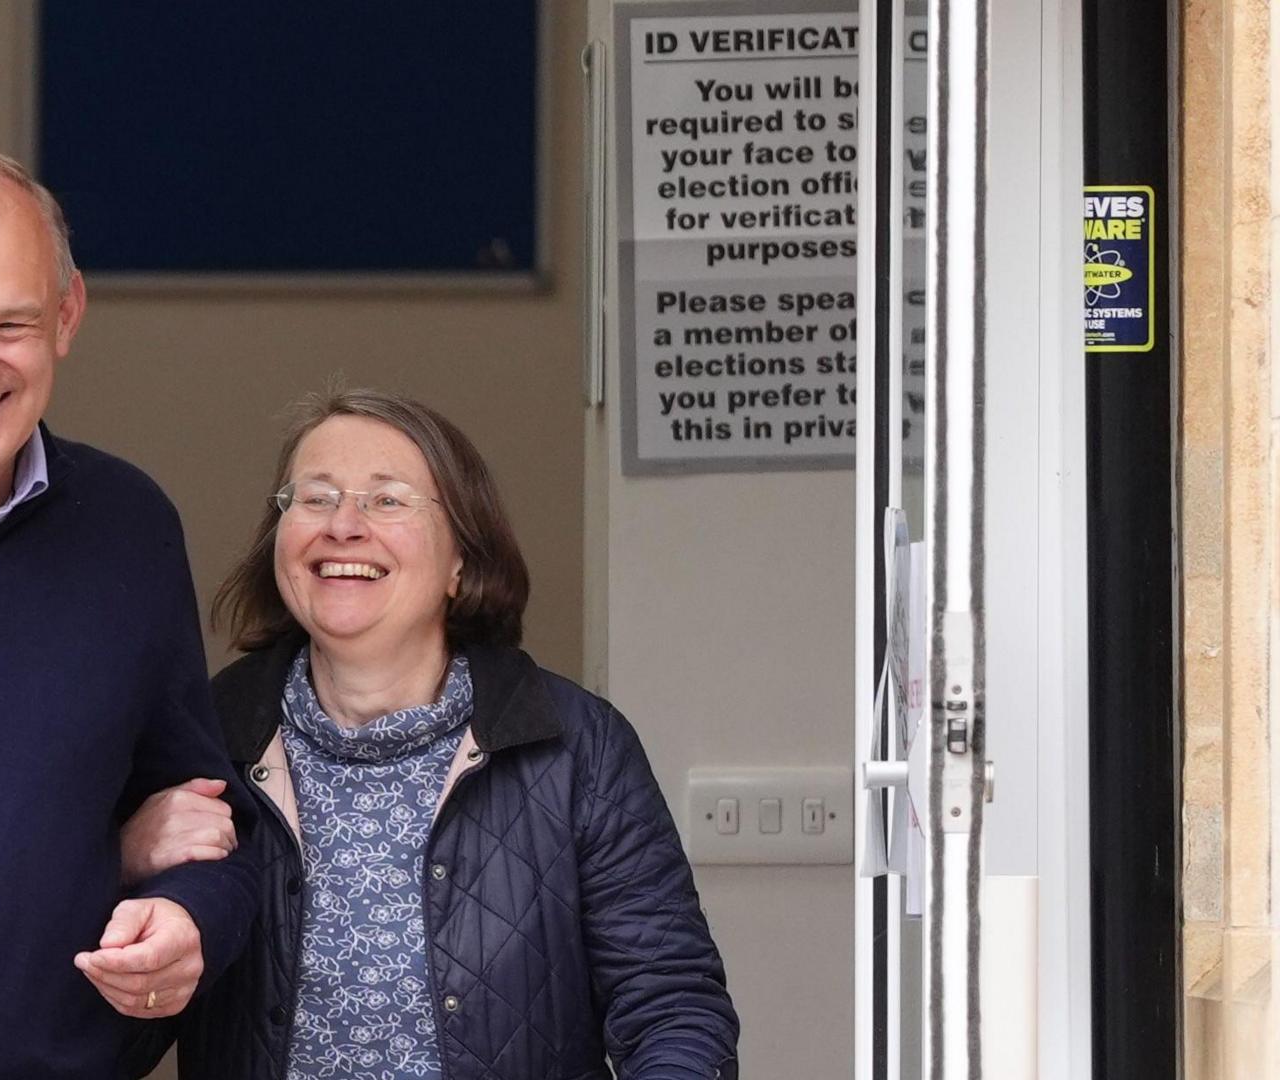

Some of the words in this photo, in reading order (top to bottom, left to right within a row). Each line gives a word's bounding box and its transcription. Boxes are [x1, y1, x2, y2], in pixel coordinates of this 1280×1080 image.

[645, 32, 677, 54] ID
[689, 26, 859, 53] VERIFICAT
[695, 79, 752, 102] You
[765, 76, 821, 100] will
[646, 110, 783, 140] required
[794, 109, 826, 131] to
[661, 148, 732, 173] your
[743, 143, 814, 164] face
[825, 142, 857, 164] to
[658, 174, 789, 199] election
[801, 173, 857, 195] offi
[666, 208, 709, 230] for
[721, 205, 855, 228] verificat
[1083, 196, 1145, 218] EVES
[707, 240, 856, 267] purposes
[657, 291, 766, 313] Please
[778, 292, 855, 316] spea
[1093, 308, 1143, 319] SYSTEMS
[654, 328, 671, 346] a
[684, 321, 818, 345] member
[1088, 319, 1105, 329] USE
[655, 353, 805, 378] elections
[659, 391, 715, 416] you
[728, 385, 826, 416] prefer
[671, 417, 731, 441] this
[743, 416, 771, 439] in
